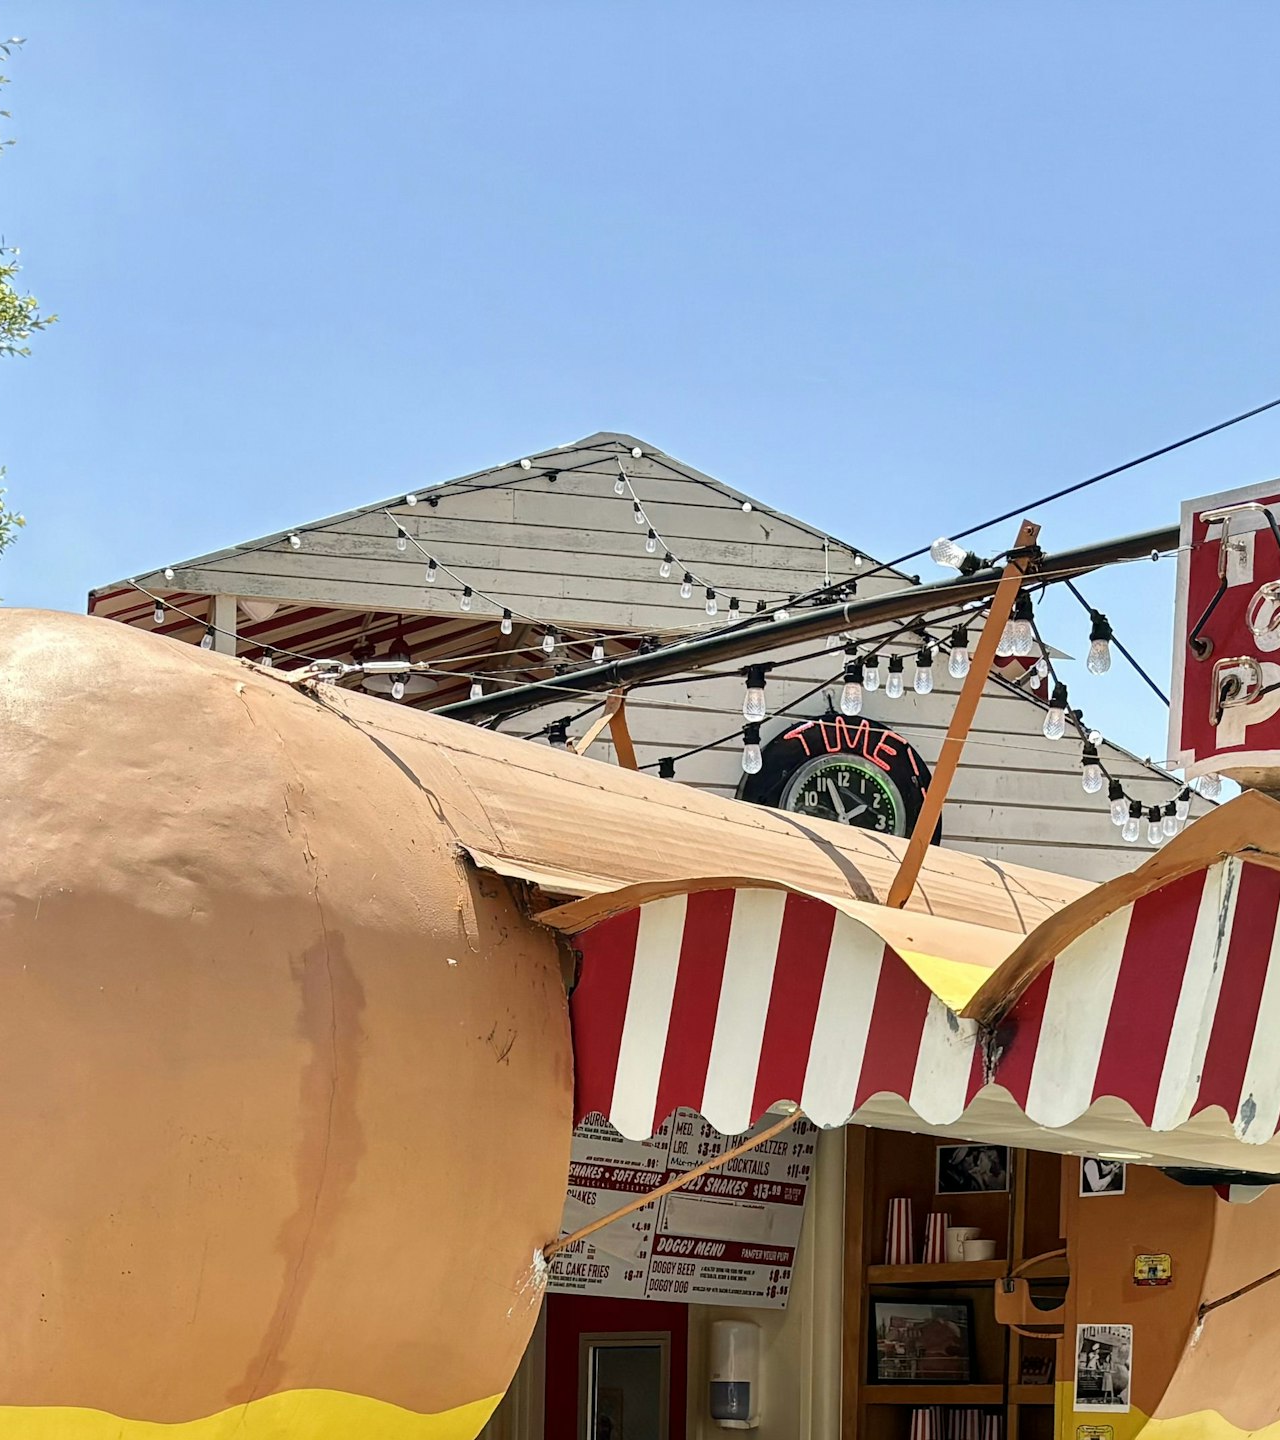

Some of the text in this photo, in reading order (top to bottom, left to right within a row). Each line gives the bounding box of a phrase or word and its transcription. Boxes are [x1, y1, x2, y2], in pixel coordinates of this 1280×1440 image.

[838, 772, 850, 787] 12
[804, 791, 818, 807] 10
[873, 793, 881, 809] 2
[875, 814, 886, 830] 3
[676, 1122, 693, 1136] MED.
[569, 1164, 662, 1186] SHAKES SOFT SERVE
[727, 1158, 770, 1176] COCKTAILS
[705, 1177, 749, 1196] SHAKES
[657, 1238, 695, 1255] DOGGY
[694, 1241, 726, 1258] MENU
[566, 1262, 586, 1276] CAKE
[588, 1264, 610, 1278] FRIES
[652, 1260, 677, 1275] DOGGY
[678, 1263, 696, 1276] BEER
[648, 1278, 673, 1292] DOGGY
[673, 1281, 689, 1293] DOG
